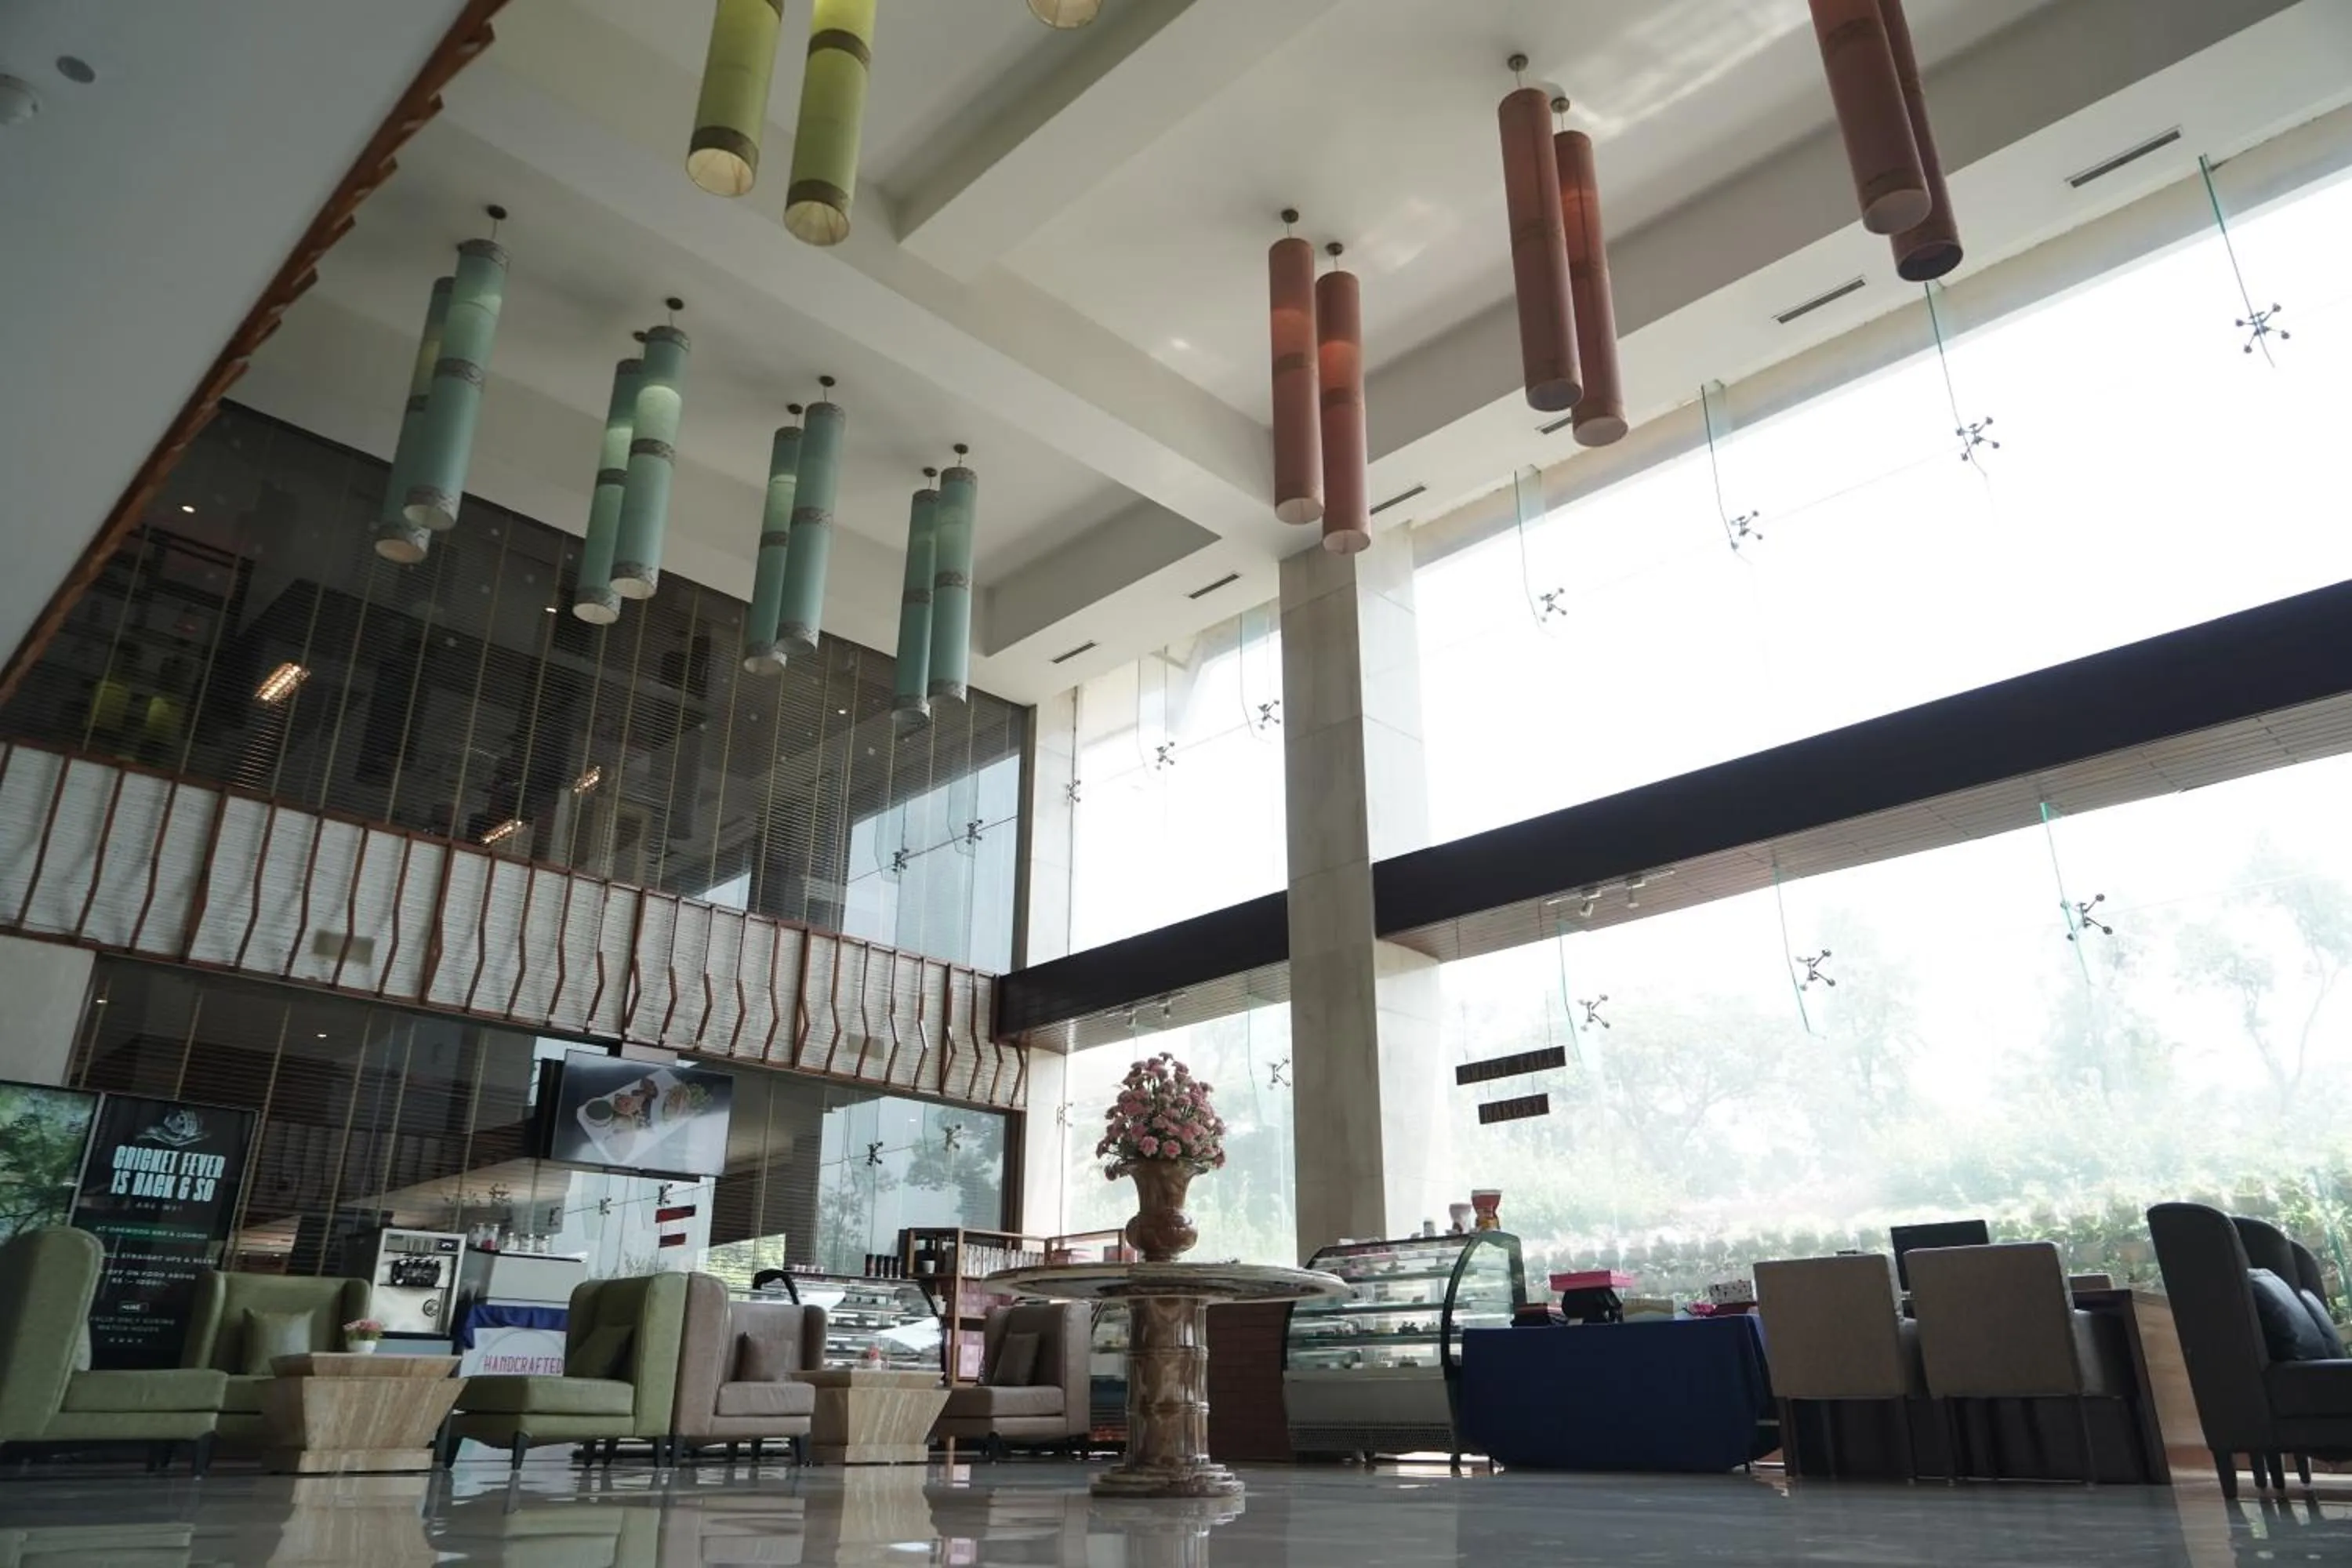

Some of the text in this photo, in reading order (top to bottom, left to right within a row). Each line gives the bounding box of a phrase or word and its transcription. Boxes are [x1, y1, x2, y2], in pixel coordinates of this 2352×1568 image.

[112, 1145, 226, 1178] CRICKET FEVER
[111, 1170, 216, 1202] IS BACK & SO
[483, 1355, 564, 1374] HANDCRAFTED
